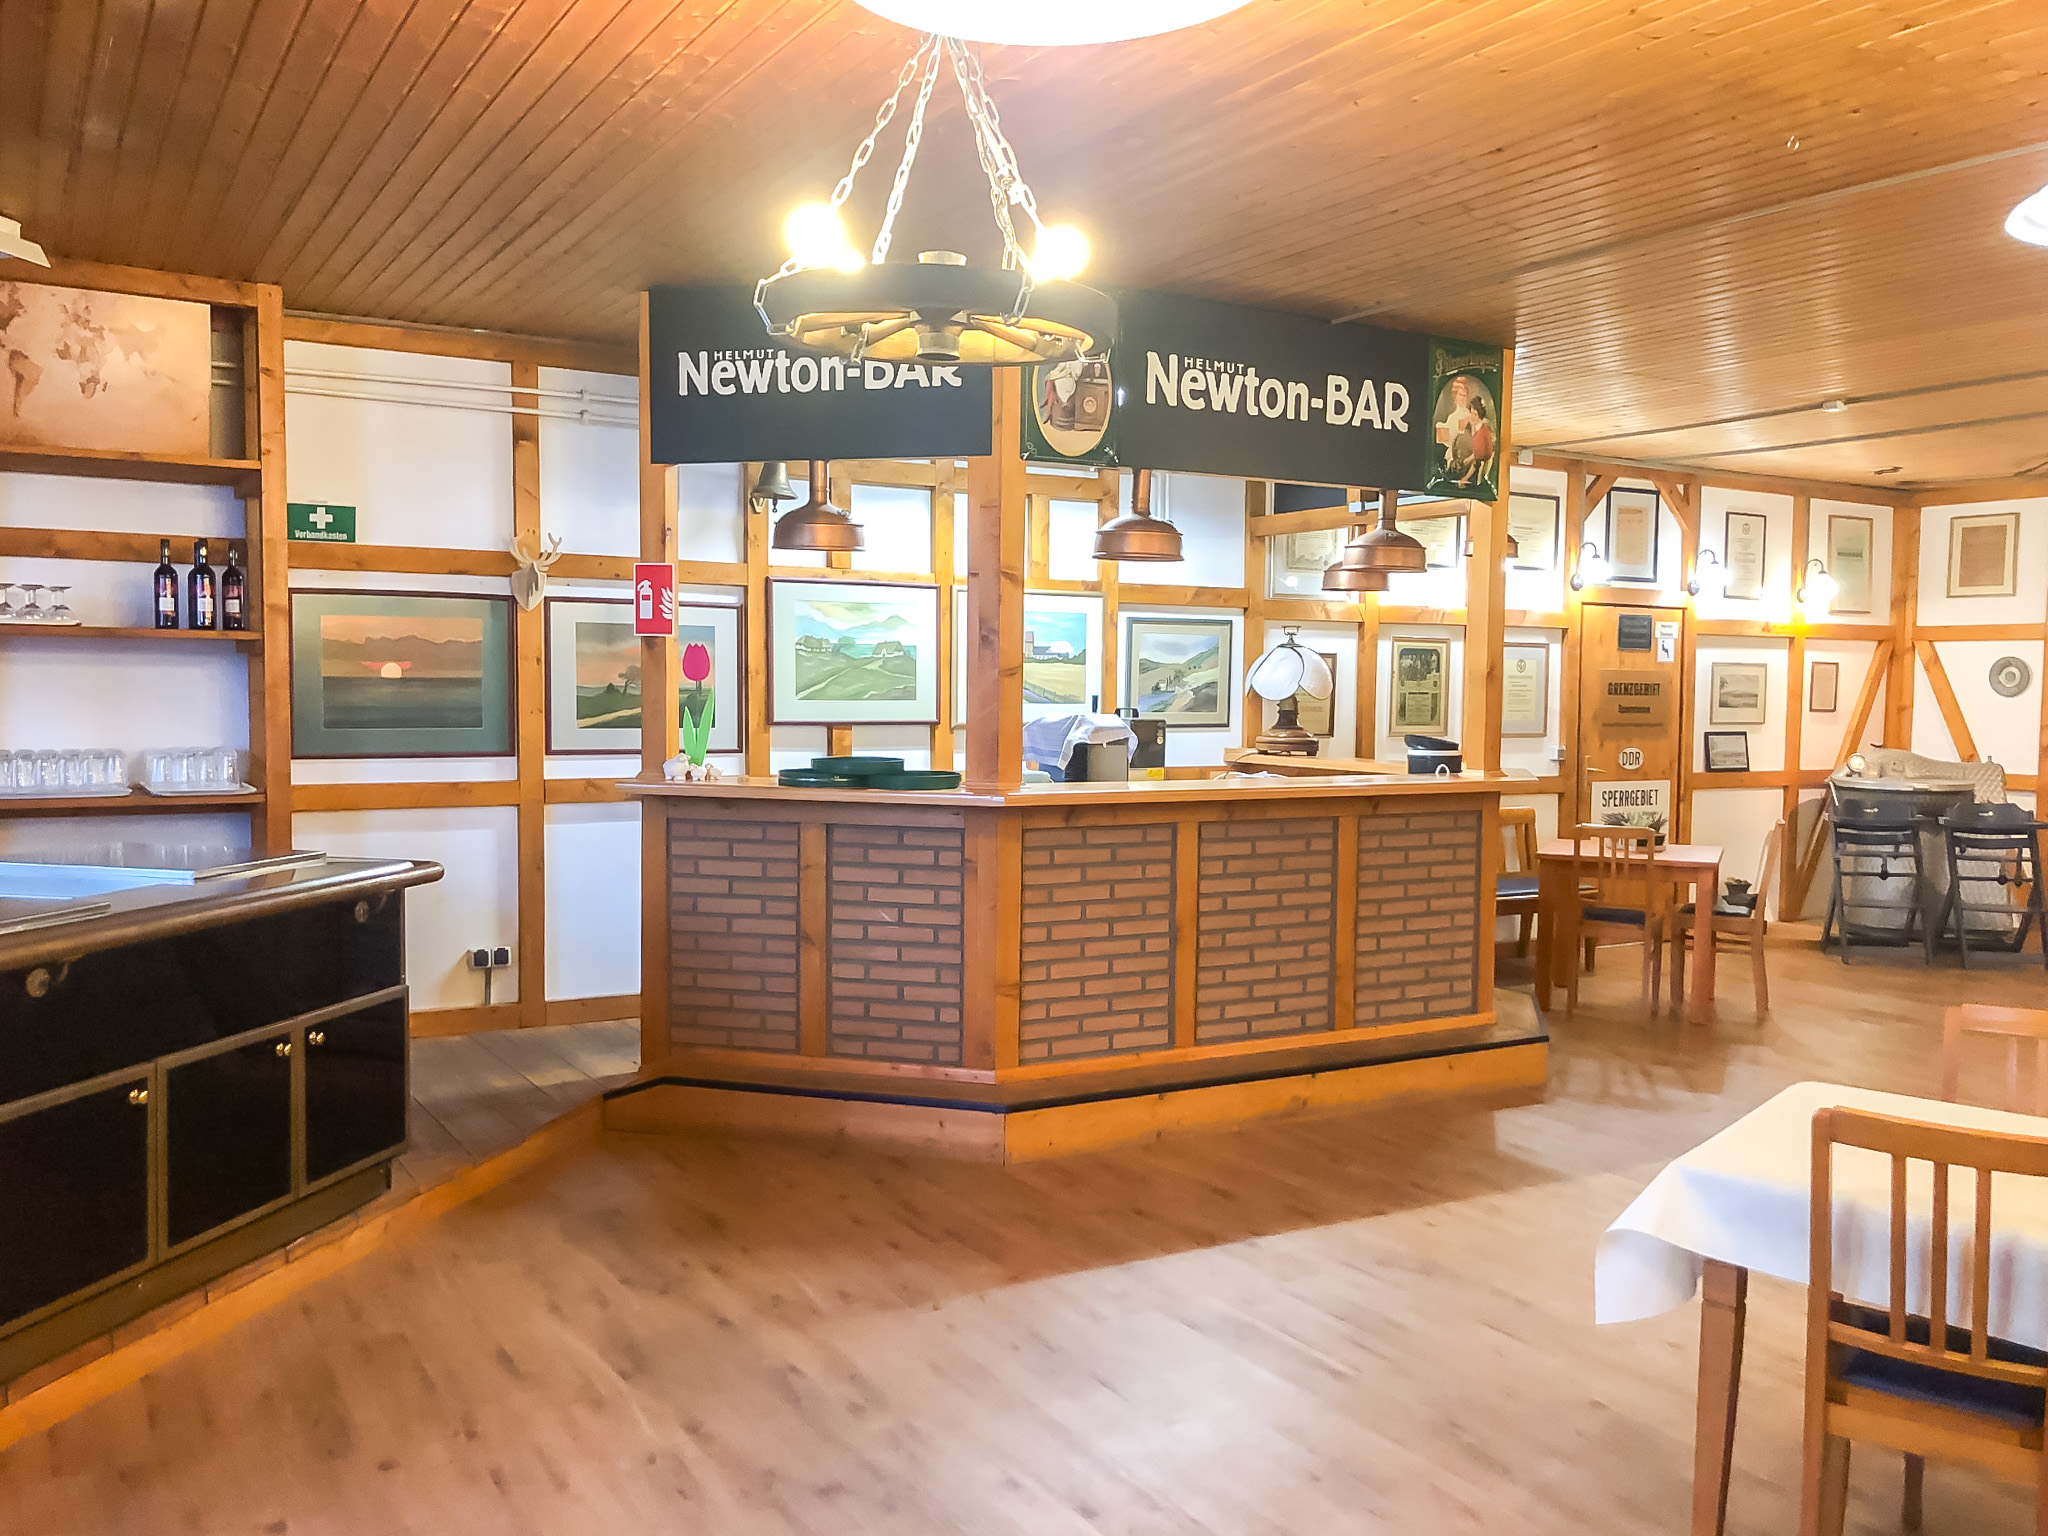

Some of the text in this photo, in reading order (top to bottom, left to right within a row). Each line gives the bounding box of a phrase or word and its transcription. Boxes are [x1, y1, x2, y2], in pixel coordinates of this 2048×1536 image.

[713, 349, 775, 361] HELMUT
[1184, 356, 1245, 374] HELMUT
[1146, 351, 1410, 433] Newton-BAR
[294, 529, 348, 540] Verbandkasten
[1621, 751, 1641, 767] DDR
[1601, 789, 1659, 808] SPERRGEBIET
